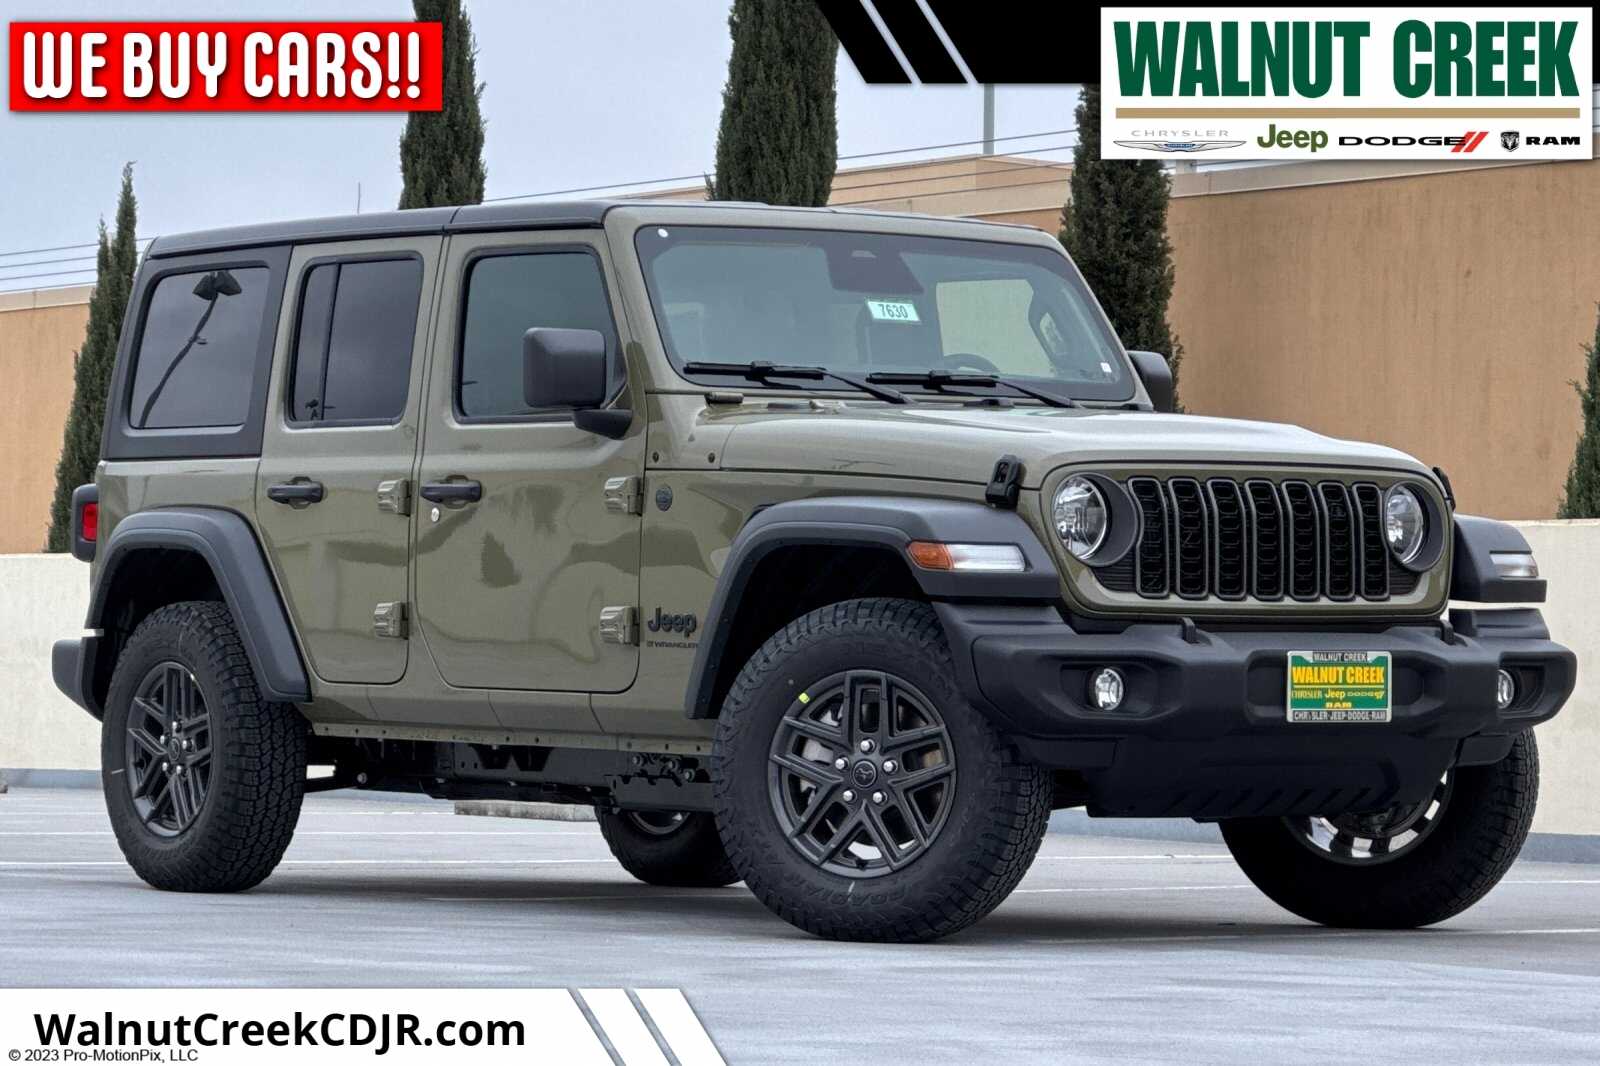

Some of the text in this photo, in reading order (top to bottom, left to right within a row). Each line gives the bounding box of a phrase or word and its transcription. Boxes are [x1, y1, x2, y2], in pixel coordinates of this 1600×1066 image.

[877, 303, 909, 318] 7630
[648, 607, 697, 638] Jeep
[1313, 652, 1367, 662] WALNUT CREEK
[1292, 666, 1385, 684] WALNUT CREEK
[1325, 688, 1346, 701] Jeep
[1325, 702, 1352, 710] RAM
